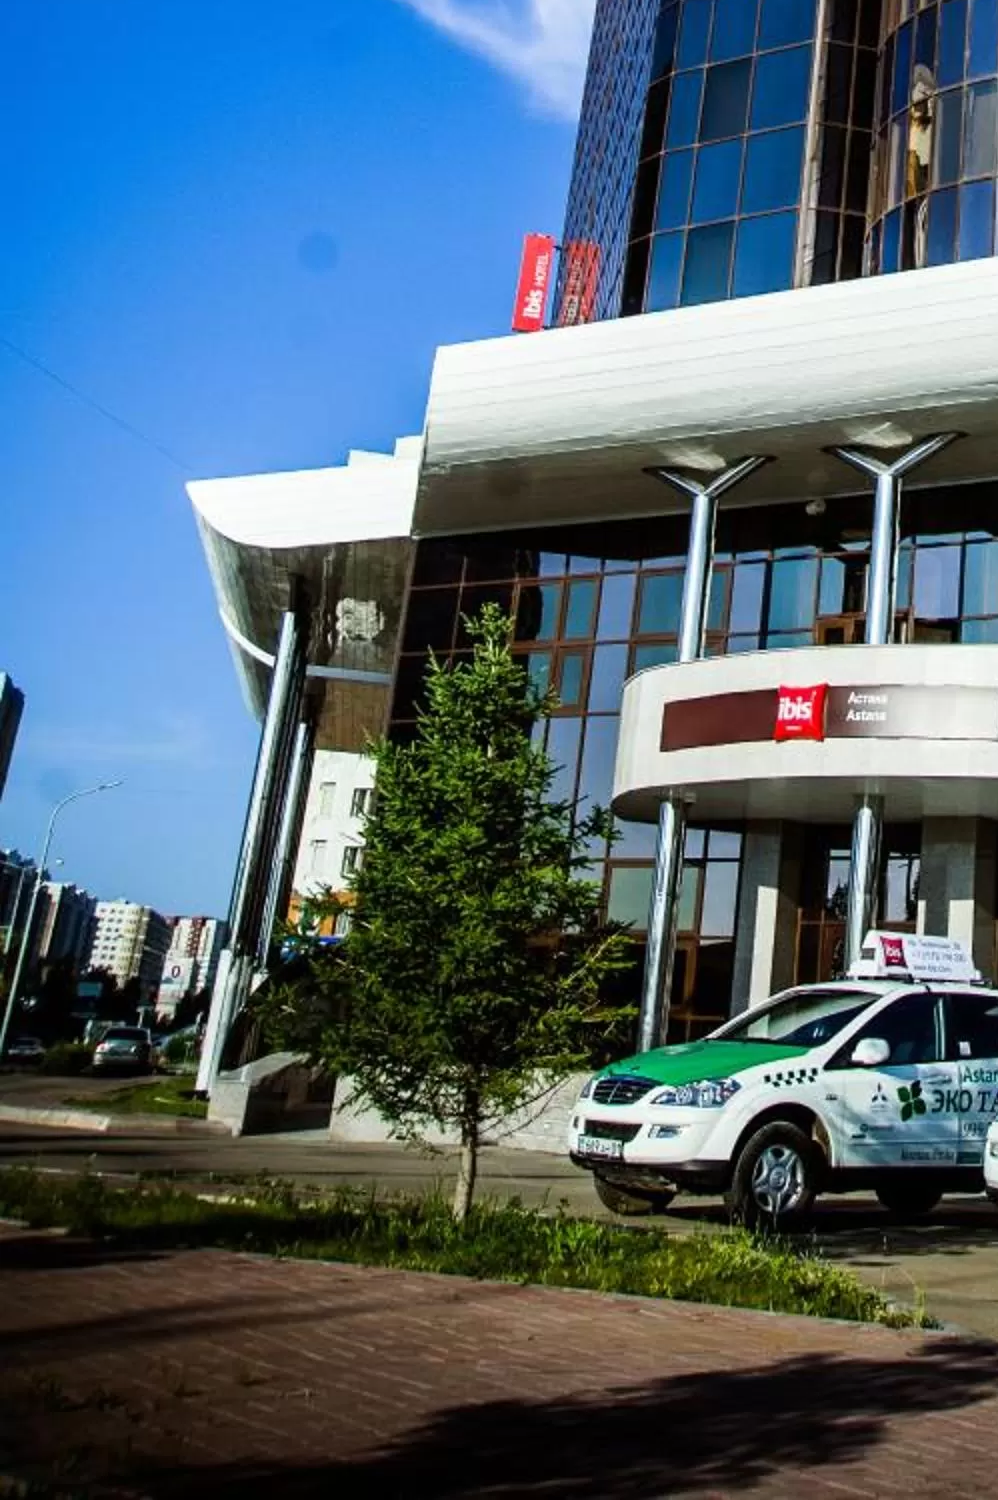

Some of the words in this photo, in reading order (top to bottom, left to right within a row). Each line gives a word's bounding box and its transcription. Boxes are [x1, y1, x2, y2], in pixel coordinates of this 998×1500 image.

[521, 289, 544, 319] ibis
[777, 695, 813, 721] ibis
[931, 1090, 973, 1113] ЭКО
